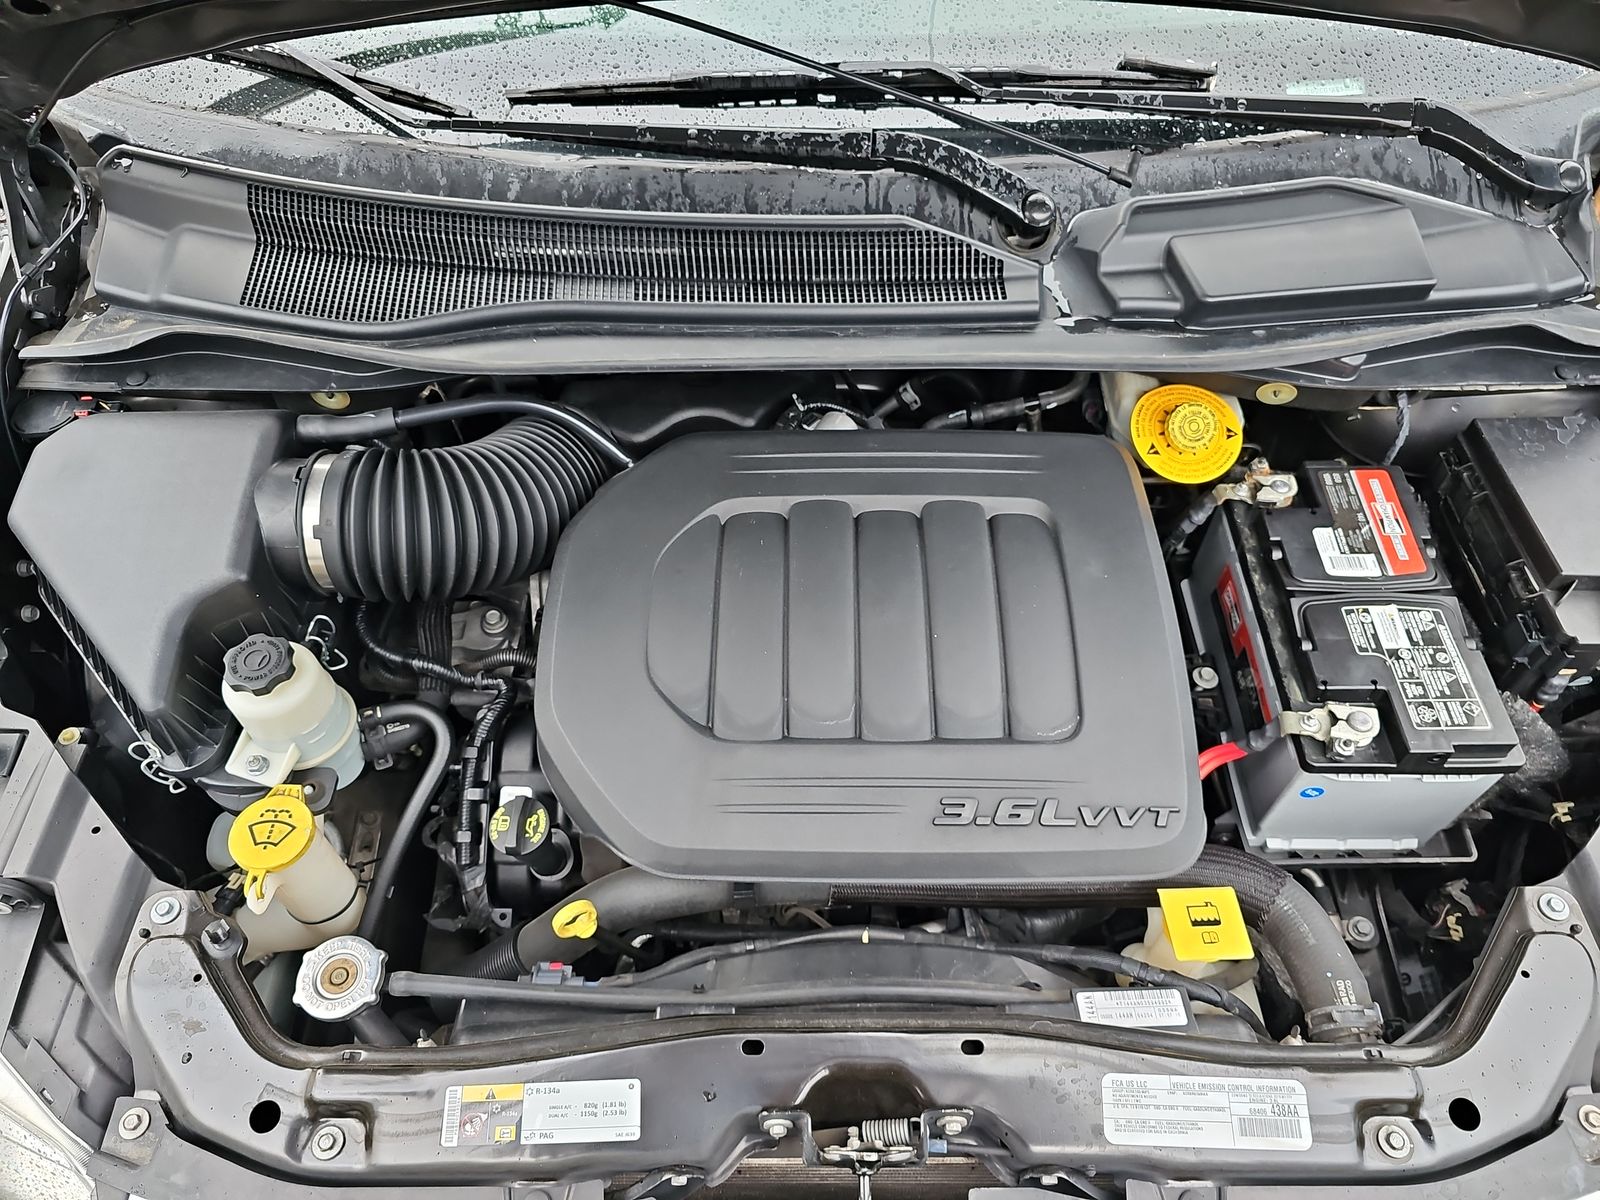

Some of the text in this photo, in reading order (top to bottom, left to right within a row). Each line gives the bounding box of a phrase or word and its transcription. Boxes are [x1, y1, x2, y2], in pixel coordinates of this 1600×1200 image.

[1378, 503, 1396, 533] CHAMPION
[1336, 979, 1348, 997] RAD
[1256, 1085, 1296, 1093] INFORMATION
[1270, 1104, 1299, 1117] 438AA
